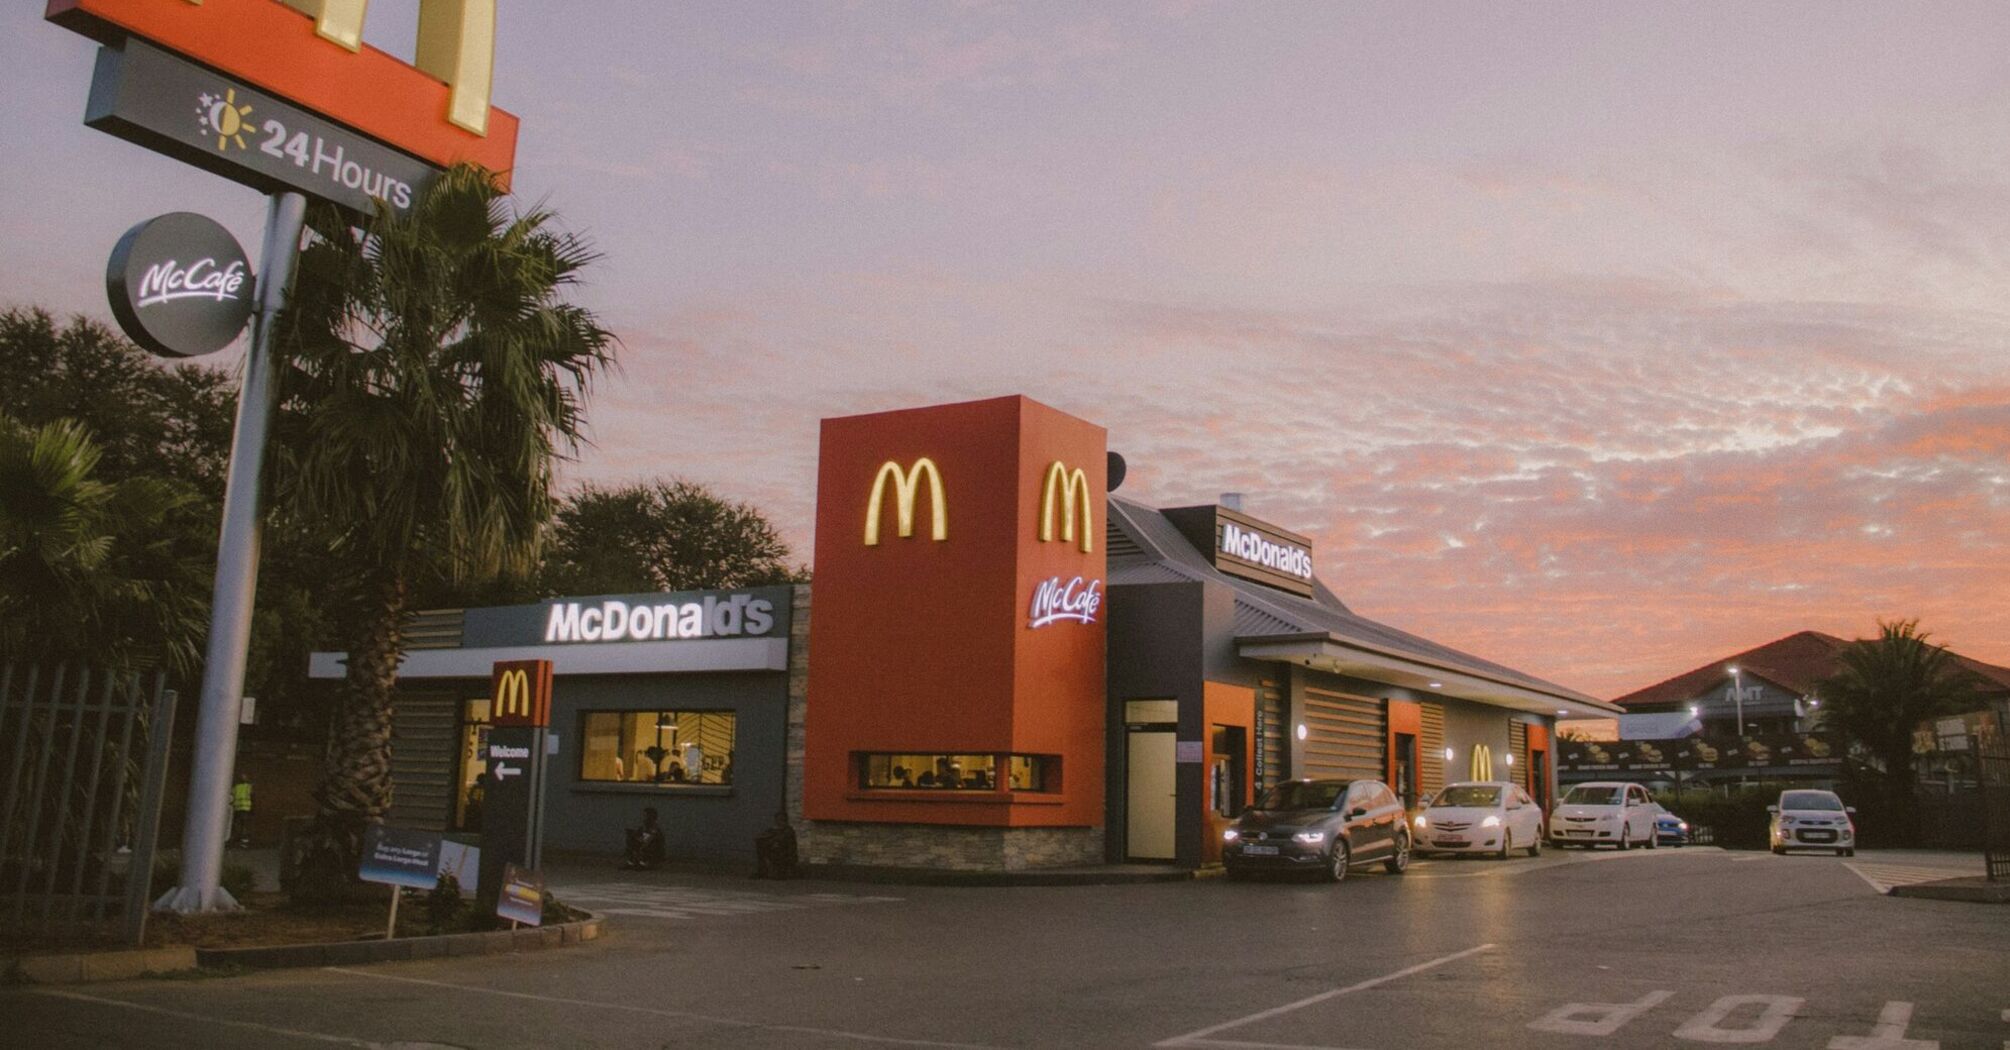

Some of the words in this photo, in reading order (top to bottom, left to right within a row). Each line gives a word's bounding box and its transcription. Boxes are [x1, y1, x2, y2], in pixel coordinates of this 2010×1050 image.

[260, 119, 310, 167] 24
[311, 137, 413, 210] Hours
[140, 257, 245, 306] McCafé
[1222, 523, 1312, 579] McDonald's
[545, 594, 773, 642] McDonald's
[1031, 576, 1102, 629] McCafé
[1256, 710, 1264, 735] Here
[490, 745, 529, 758] Welcome
[1255, 737, 1263, 776] Collect
